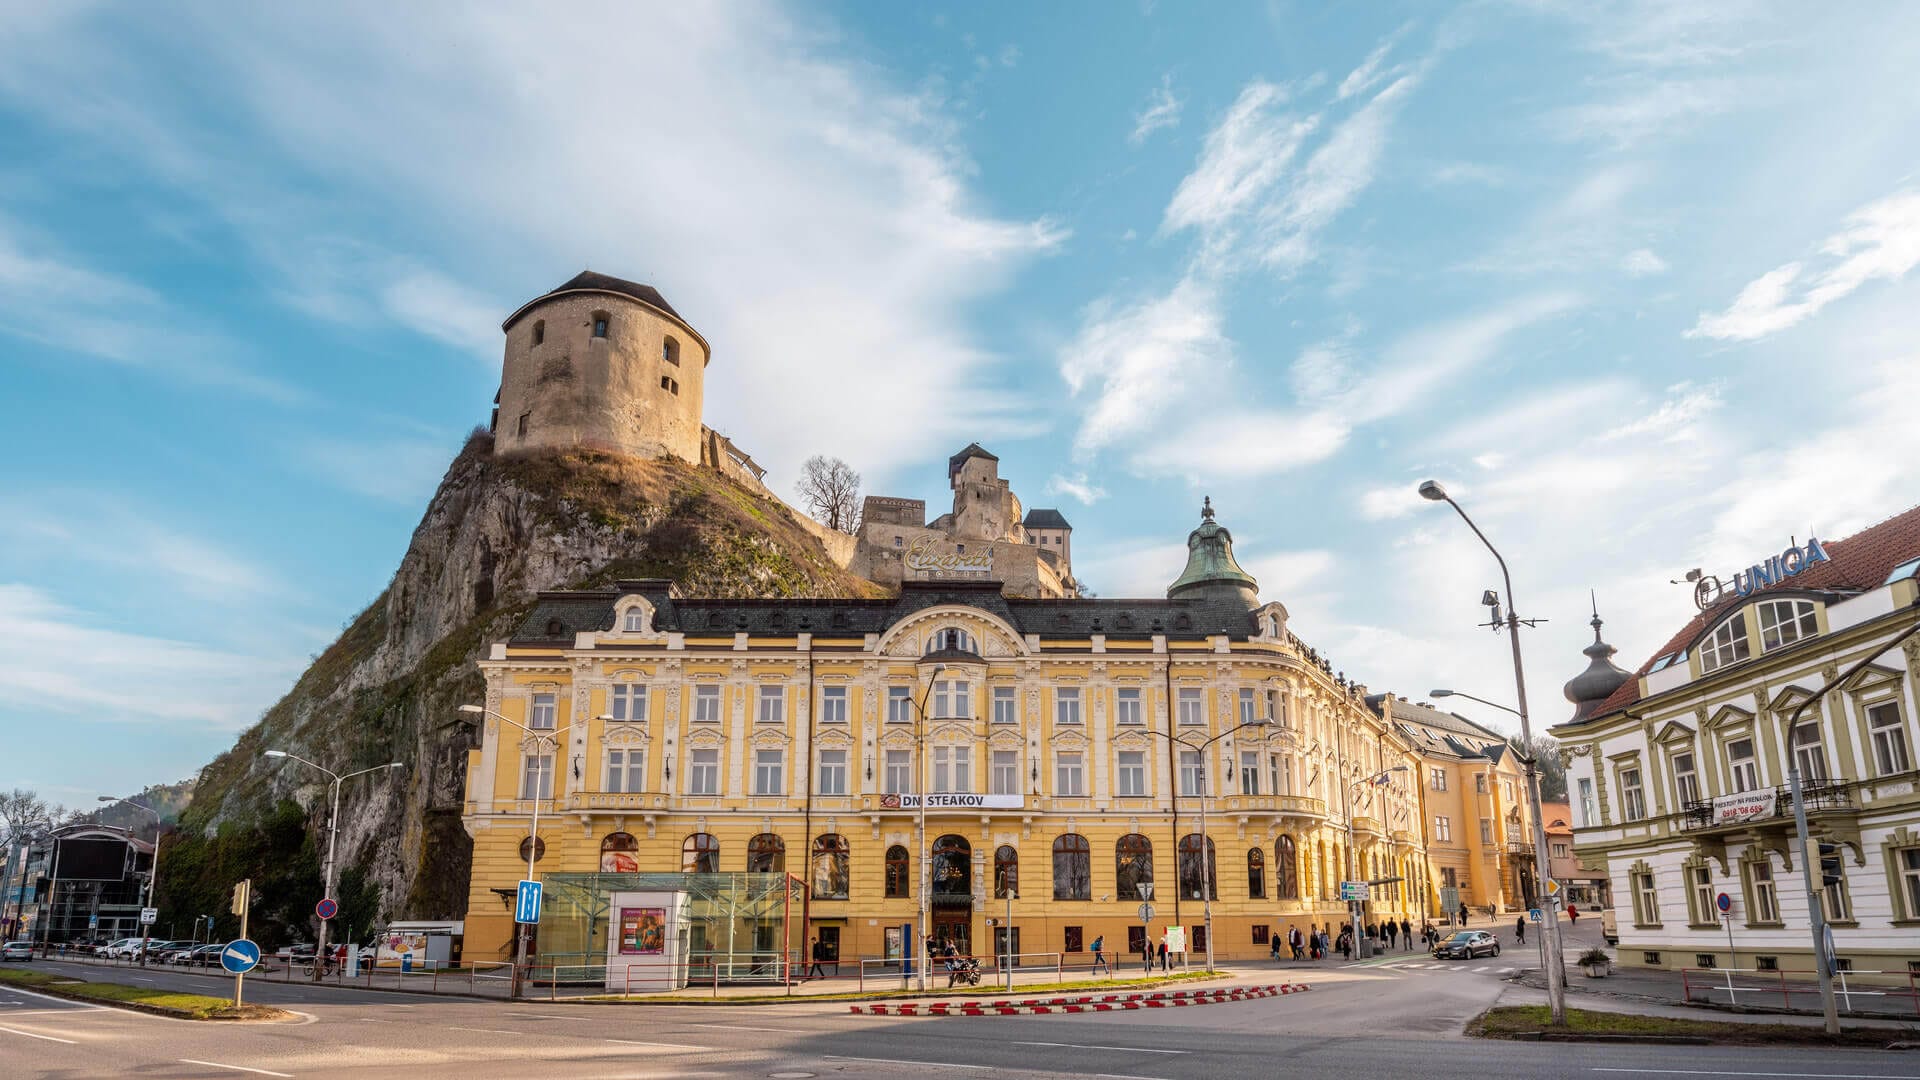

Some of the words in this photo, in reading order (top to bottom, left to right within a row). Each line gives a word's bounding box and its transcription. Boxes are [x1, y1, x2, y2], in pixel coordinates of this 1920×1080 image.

[1734, 537, 1831, 597] UNIQA
[903, 796, 921, 806] DN
[927, 795, 984, 806] STEAKOV
